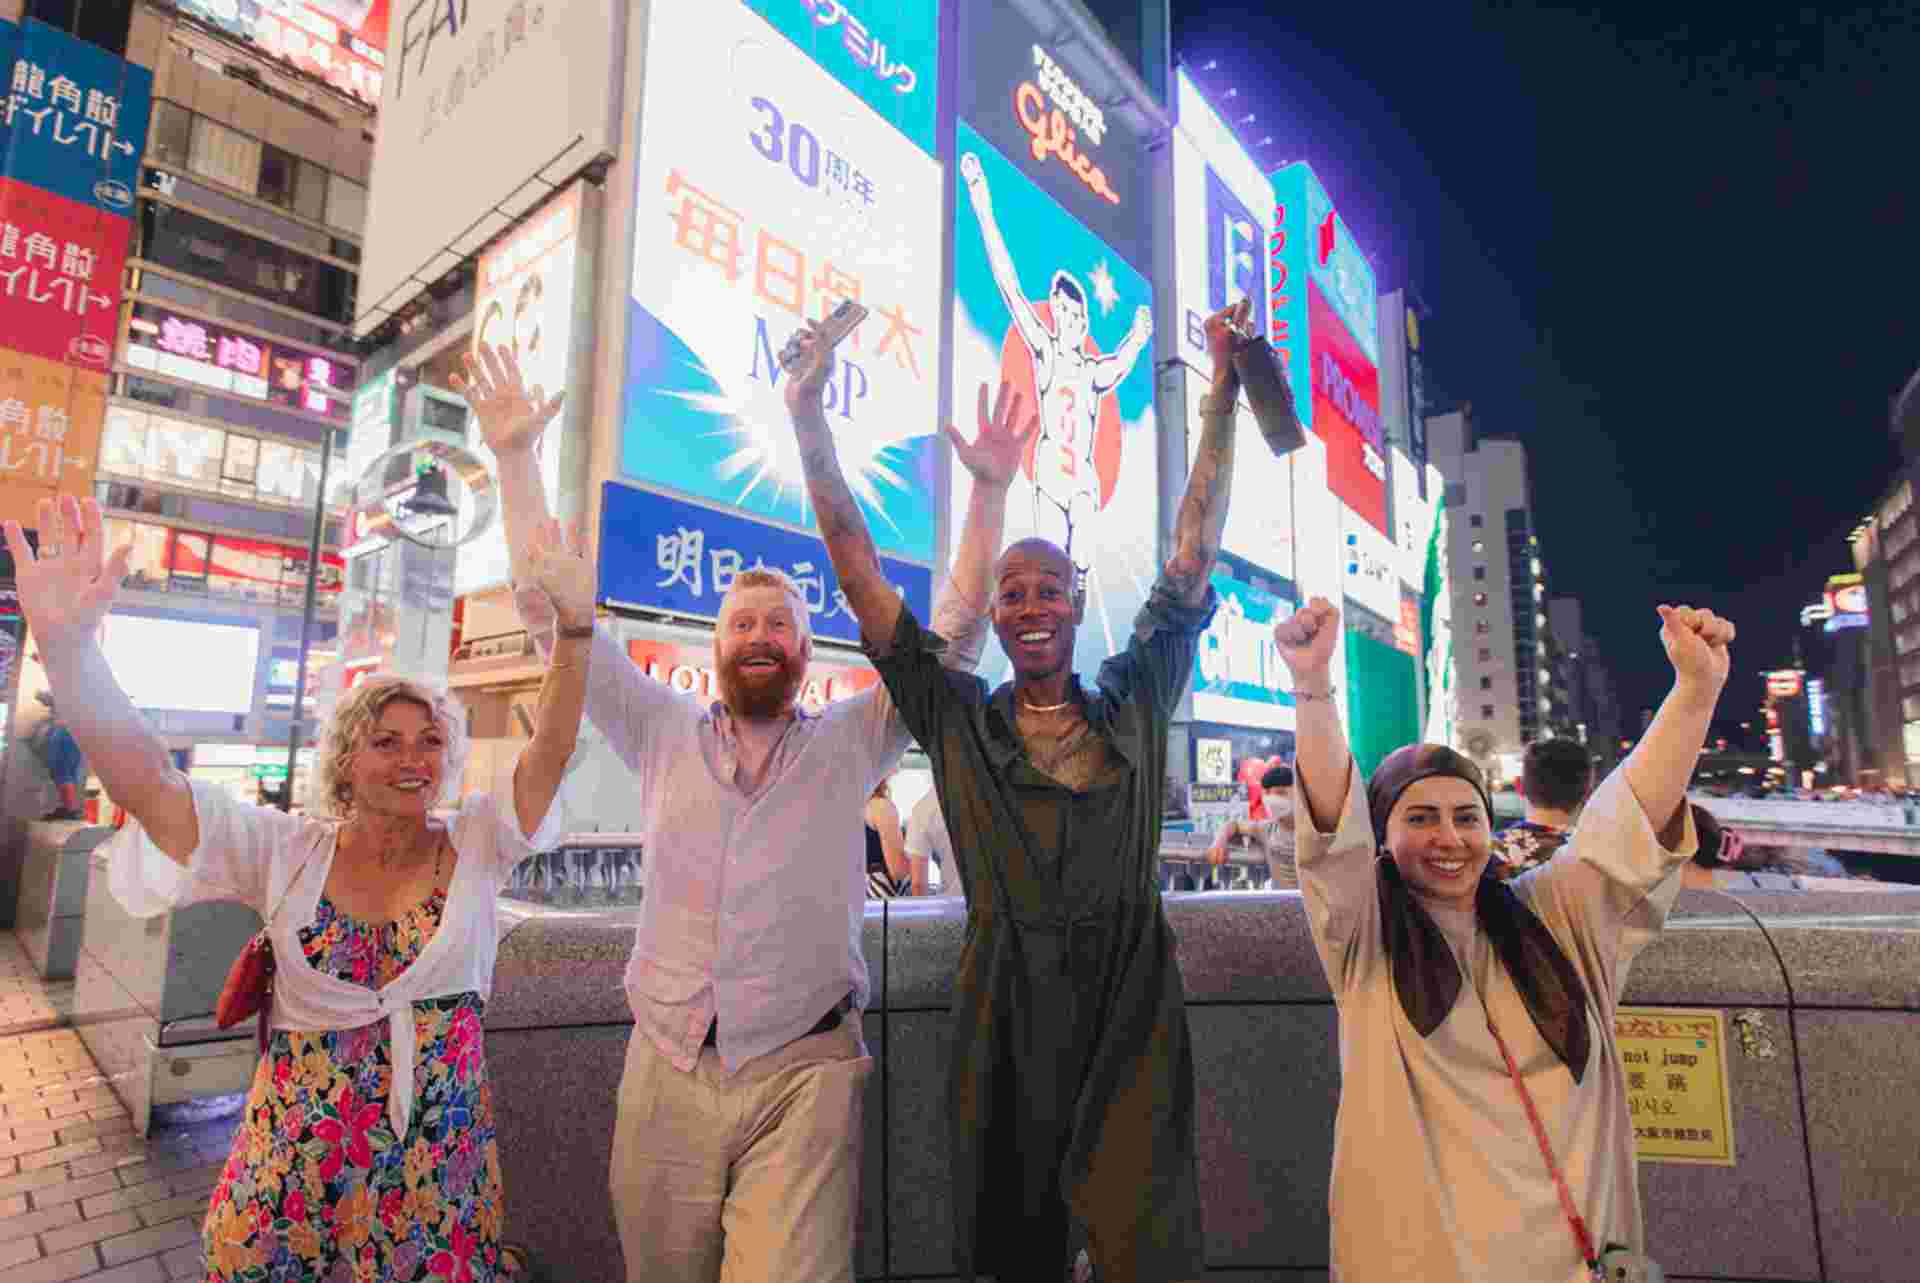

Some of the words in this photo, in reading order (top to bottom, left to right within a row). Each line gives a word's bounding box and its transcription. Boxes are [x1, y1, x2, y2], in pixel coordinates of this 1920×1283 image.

[800, 0, 917, 94] グミルク
[1015, 80, 1121, 204] Glico
[1623, 1050, 1649, 1064] not
[1662, 1048, 1698, 1067] jump
